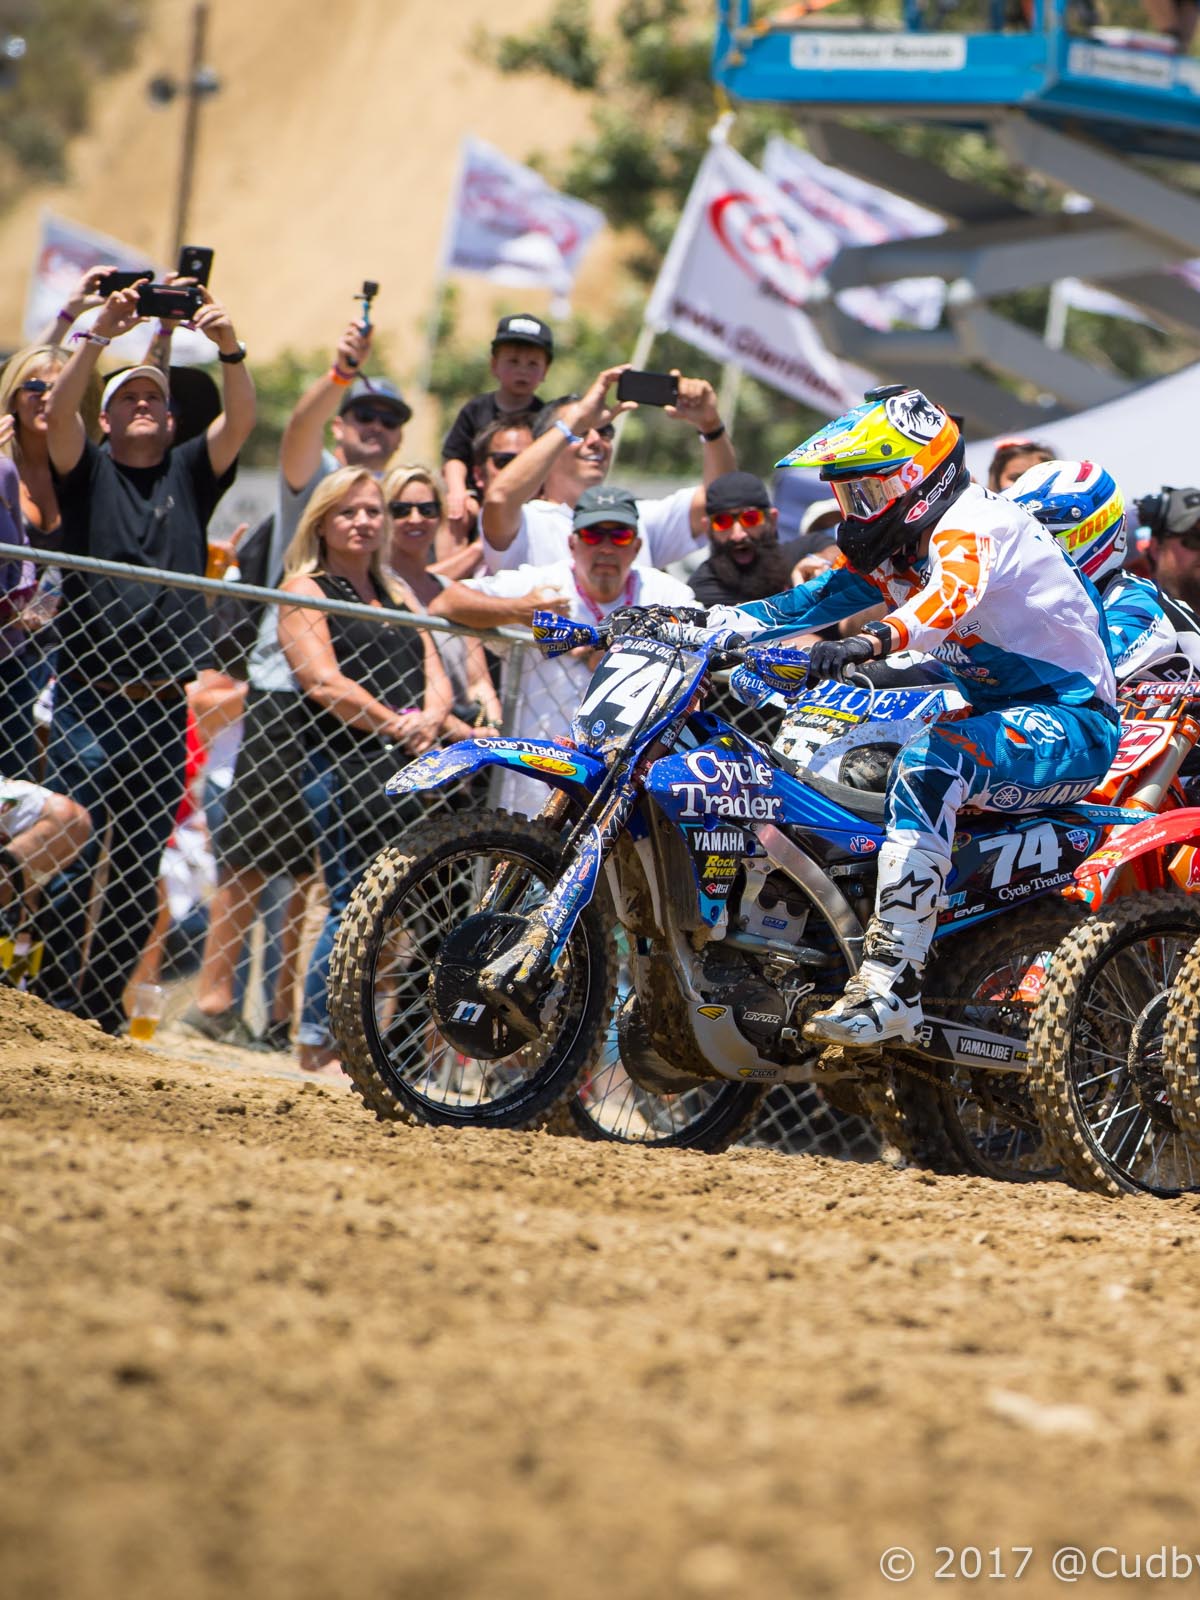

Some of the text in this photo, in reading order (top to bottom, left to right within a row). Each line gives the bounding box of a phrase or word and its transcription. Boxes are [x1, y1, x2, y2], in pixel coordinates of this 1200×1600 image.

[631, 640, 673, 659] LUCAS OIL
[578, 653, 685, 727] 74
[474, 738, 572, 761] Cycle Trader
[687, 752, 773, 792] Cycle
[672, 784, 781, 819] Trader
[694, 832, 745, 851] YAMAHA
[705, 855, 736, 868] ROCK
[979, 823, 1062, 889] 74
[703, 867, 737, 879] RIVER
[999, 872, 1073, 900] Cycle Trader
[743, 1012, 783, 1025] GYTR
[959, 1037, 1010, 1060] YAMALUBE
